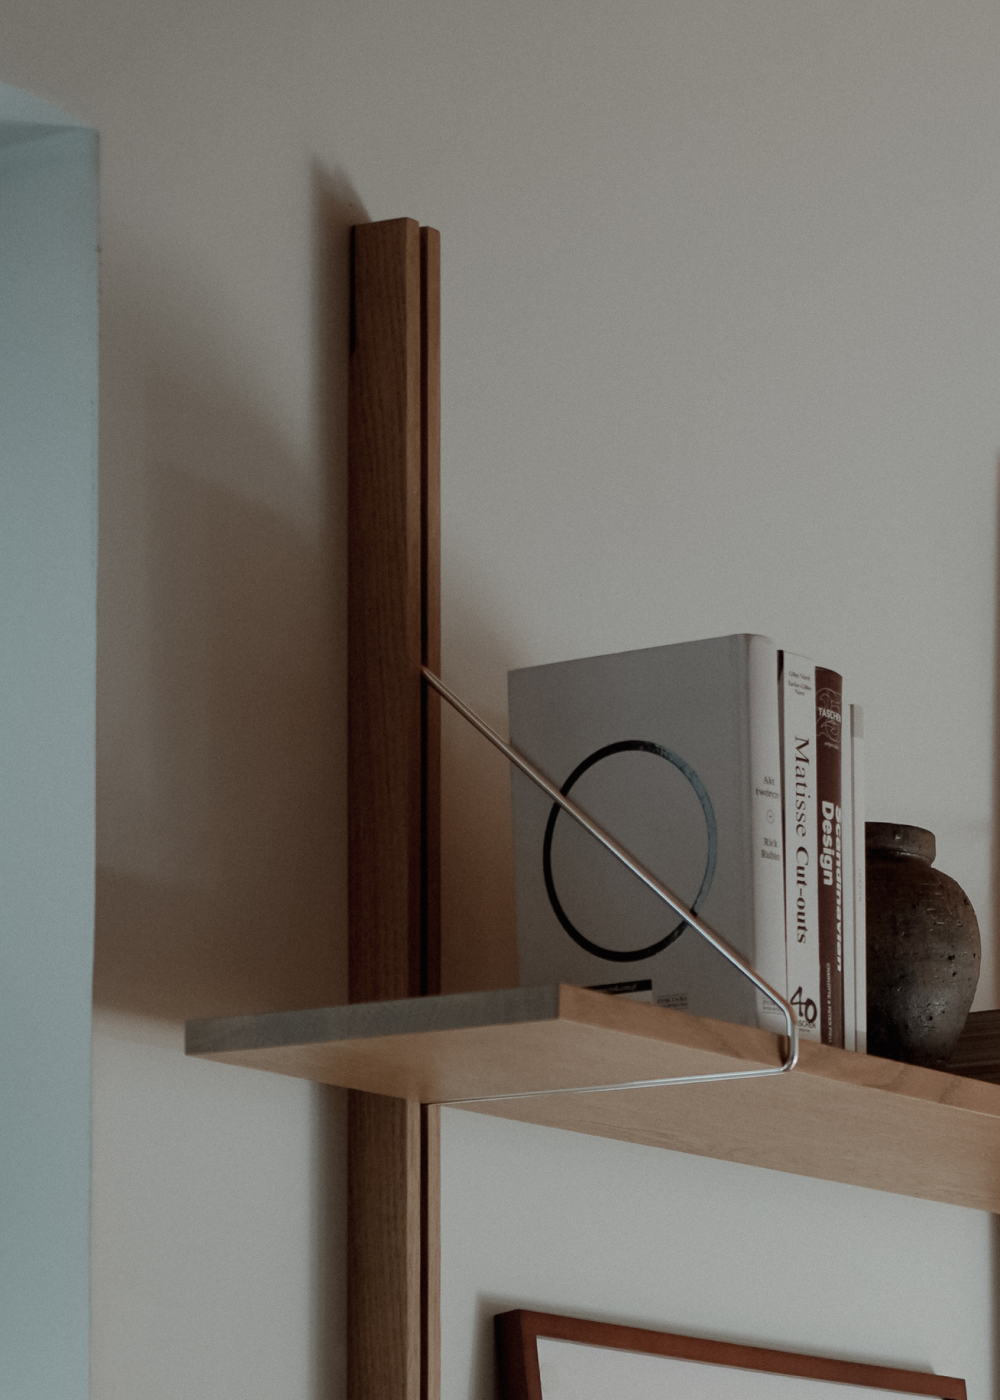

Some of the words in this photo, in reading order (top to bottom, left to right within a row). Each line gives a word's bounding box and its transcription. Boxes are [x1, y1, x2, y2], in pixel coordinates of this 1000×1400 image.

[795, 737, 810, 838] Matisse
[820, 801, 835, 886] Design
[796, 846, 808, 944] Cut-outs
[790, 986, 818, 1024] 40
